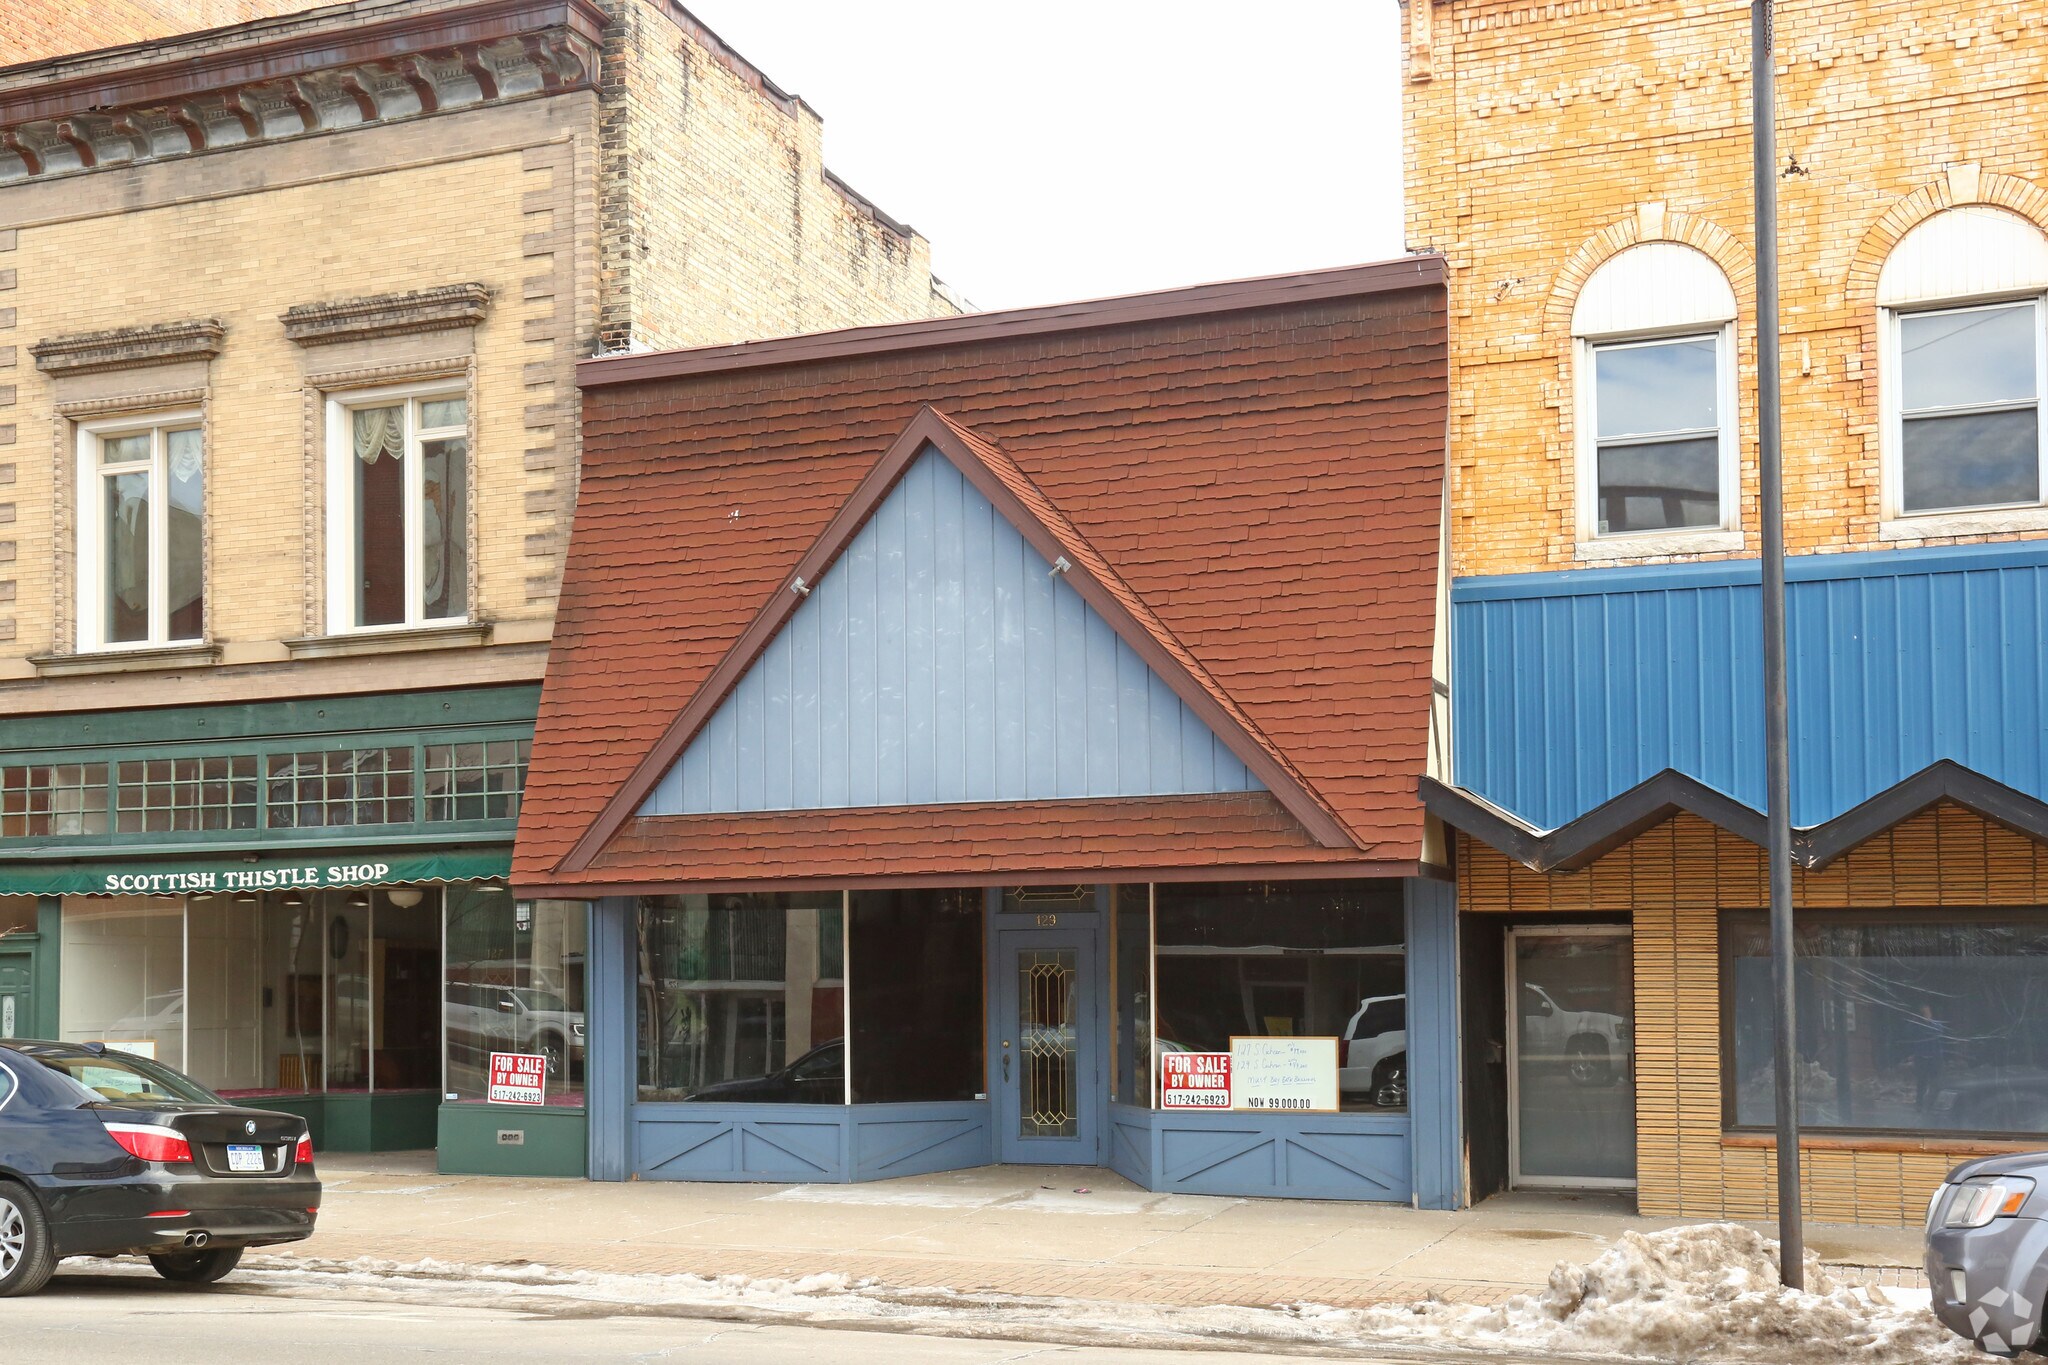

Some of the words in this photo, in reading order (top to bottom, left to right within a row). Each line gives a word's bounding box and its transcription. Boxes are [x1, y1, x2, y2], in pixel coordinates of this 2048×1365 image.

[105, 873, 216, 891] SCOTTISH
[223, 868, 319, 888] THISTLE
[327, 863, 388, 883] SHOP
[1037, 914, 1056, 926] 129
[495, 1056, 513, 1072] FOR
[517, 1058, 542, 1074] SALE
[1168, 1056, 1191, 1073] FOR
[1196, 1056, 1228, 1074] SALE
[496, 1073, 507, 1085] BY
[509, 1073, 539, 1087] OWNER
[1171, 1074, 1184, 1087] BY
[1188, 1074, 1225, 1088] OWNER
[493, 1089, 541, 1102] 517-242-6923
[1167, 1094, 1226, 1105] 517-242-6923
[1248, 1097, 1265, 1108] NOW
